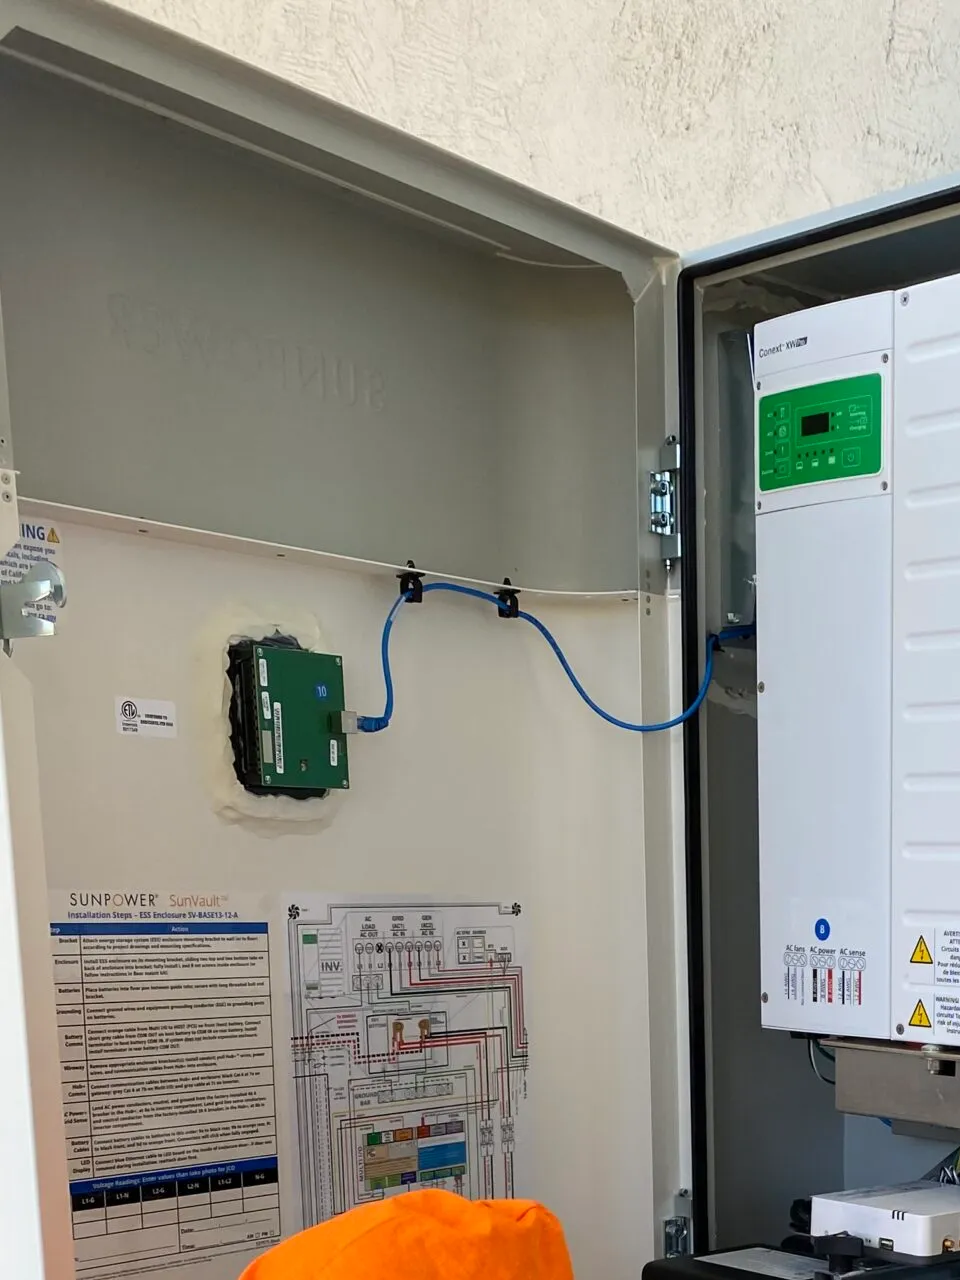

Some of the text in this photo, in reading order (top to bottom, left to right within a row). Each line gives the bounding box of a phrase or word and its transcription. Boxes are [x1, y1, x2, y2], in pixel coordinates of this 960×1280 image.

[316, 685, 327, 697] 10
[67, 911, 109, 919] Installation
[112, 911, 133, 920] Steps
[139, 911, 152, 919] ESS
[152, 911, 187, 919] Enclosure
[820, 924, 826, 934] 8
[794, 945, 805, 953] fans
[818, 947, 836, 955] power
